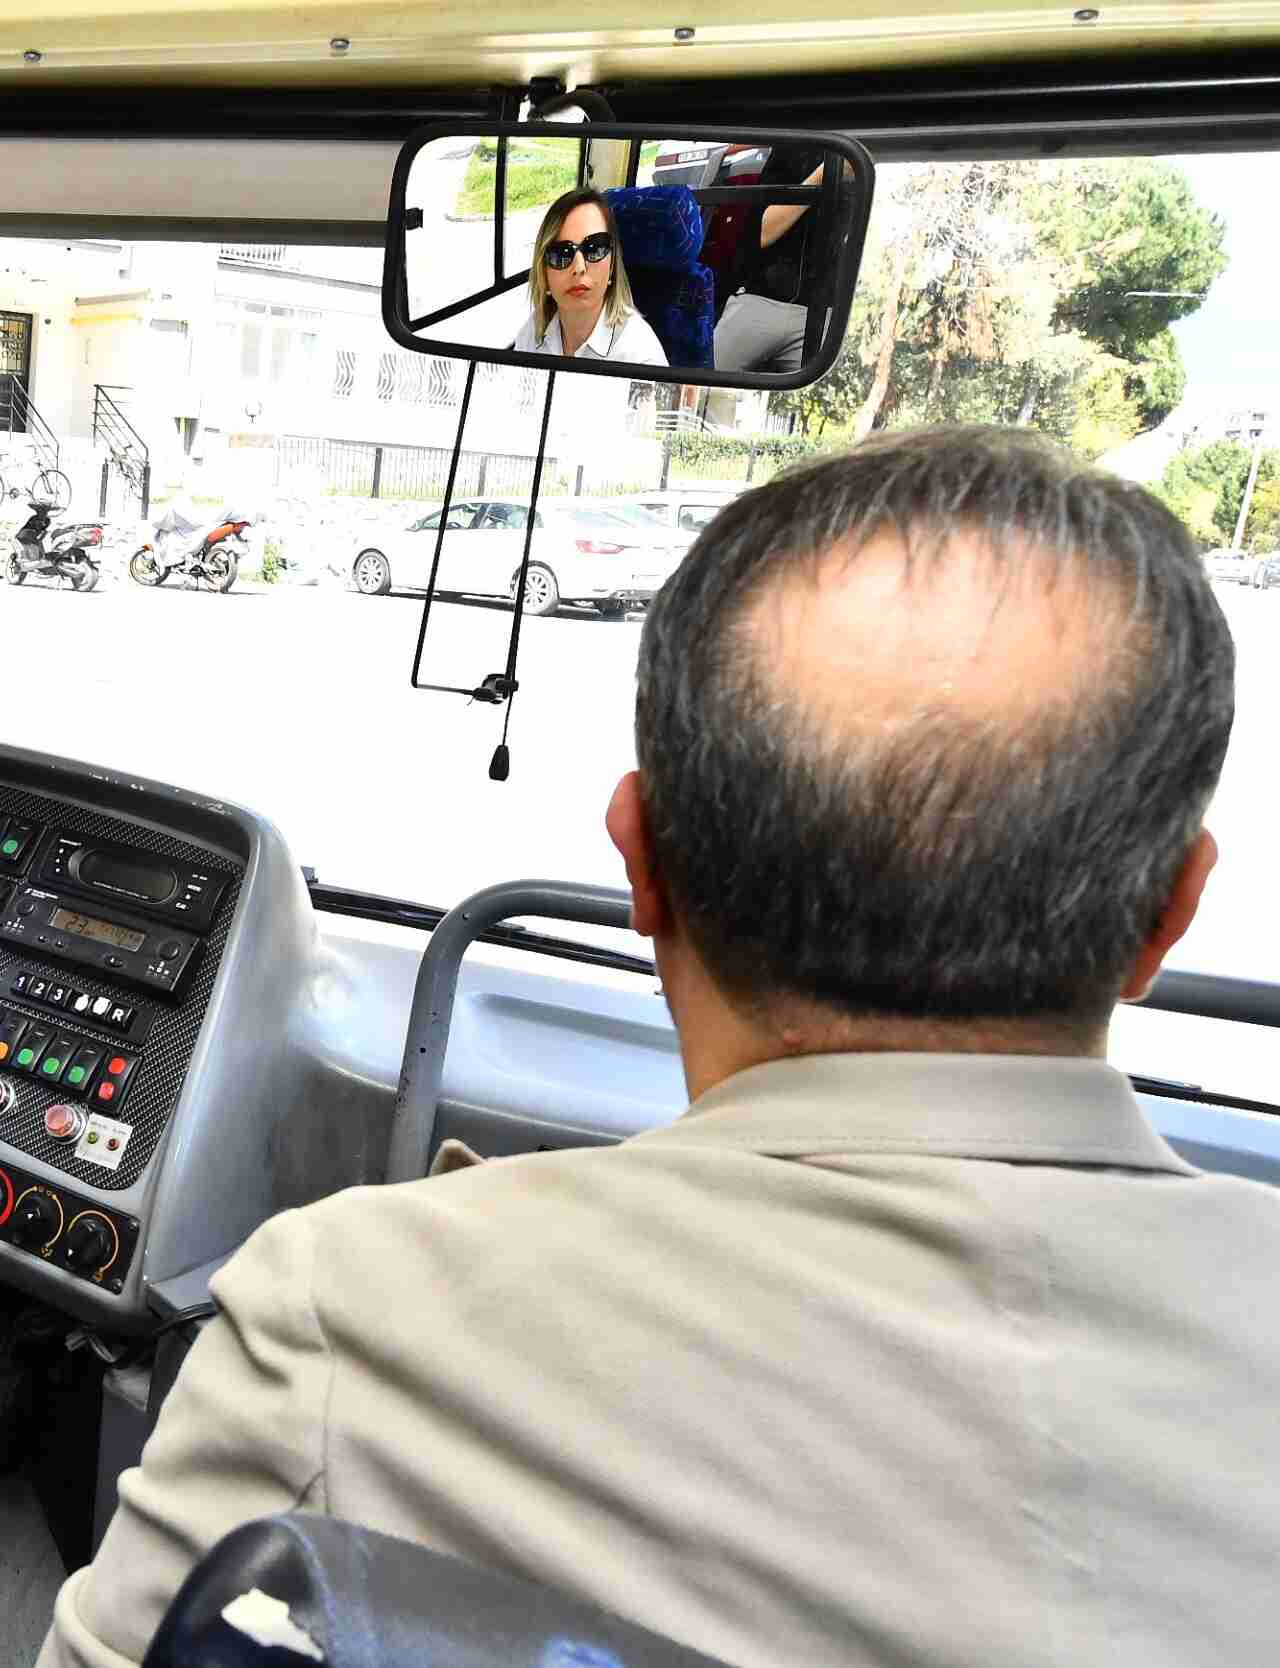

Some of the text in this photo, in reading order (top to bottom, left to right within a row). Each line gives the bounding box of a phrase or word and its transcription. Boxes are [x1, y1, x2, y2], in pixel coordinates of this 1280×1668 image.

[18, 976, 124, 1022] 1 2 3 R
